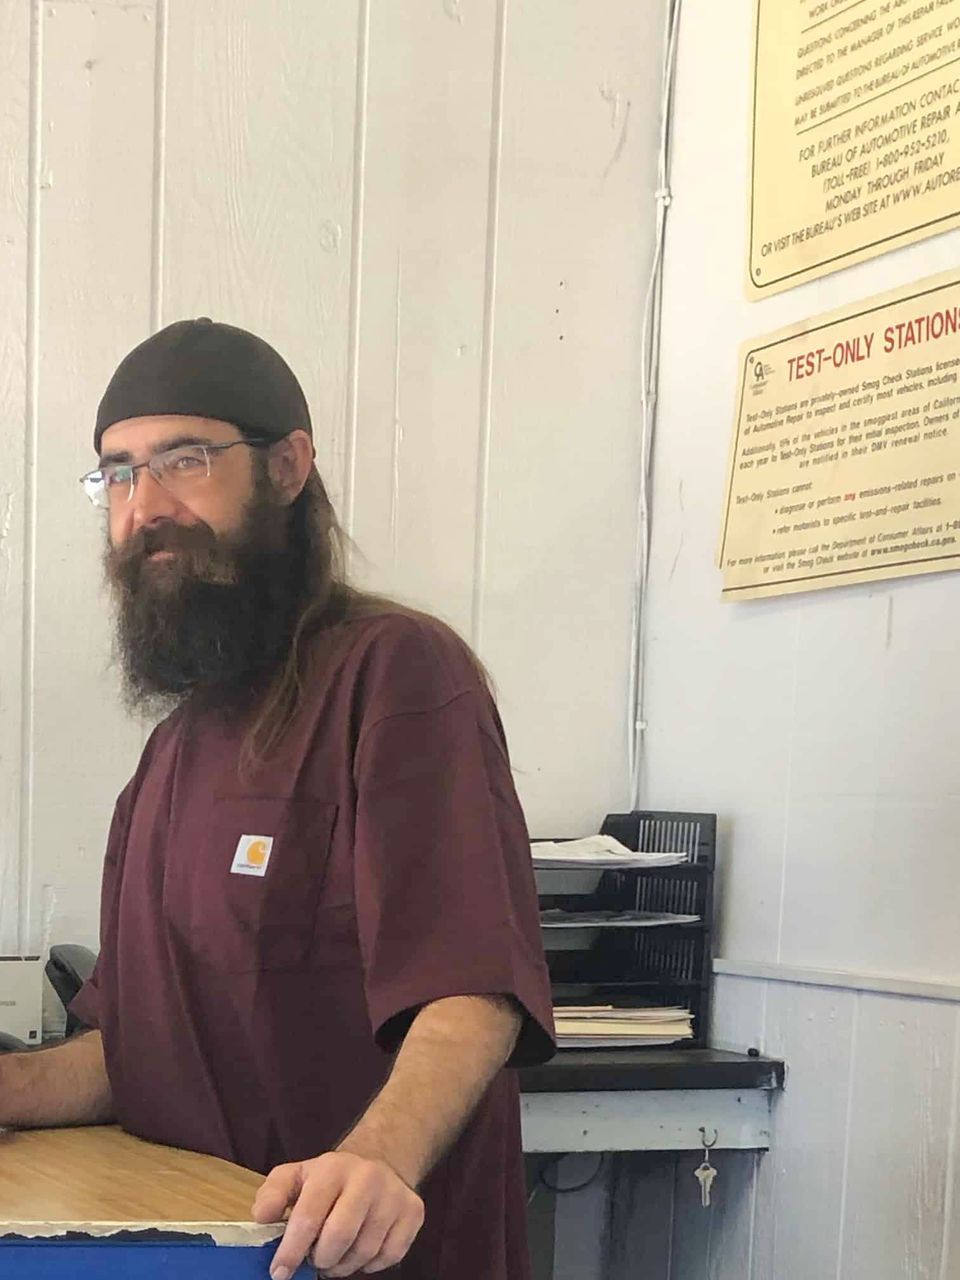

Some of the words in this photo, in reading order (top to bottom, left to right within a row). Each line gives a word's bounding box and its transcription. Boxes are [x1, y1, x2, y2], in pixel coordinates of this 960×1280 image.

[796, 58, 824, 80] DIRECTED
[826, 52, 835, 64] TO
[837, 45, 848, 59] THE
[850, 28, 884, 52] MANAGER
[885, 21, 895, 35] OF
[898, 13, 912, 28] THIS
[834, 10, 877, 40] CONCERNING
[874, 40, 913, 68] REGARDING
[916, 25, 943, 47] SERVICE
[794, 112, 808, 126] MAY
[810, 107, 817, 119] BE
[910, 40, 956, 71] AUTOMOTIVE
[798, 146, 816, 163] FOR
[818, 127, 852, 154] FURTHER
[854, 100, 917, 138] INFORMATION
[811, 156, 843, 178] BUREAU
[845, 146, 858, 162] OF
[860, 119, 917, 156] AUTOMOTIVE
[920, 104, 951, 131] REPAIR
[825, 187, 862, 213] MONDAY
[867, 166, 909, 195] THROUGH
[913, 152, 945, 176] FRIDAY
[761, 242, 773, 257] OR
[774, 235, 791, 252] VISIT
[792, 228, 805, 245] THE
[805, 214, 842, 241] BUREAU'S
[843, 206, 861, 224] WEB
[862, 199, 878, 219] SITE
[879, 194, 890, 210] AT
[787, 332, 874, 382] TEST-ONLY
[861, 379, 880, 392] Smog
[883, 372, 902, 386] Check
[906, 363, 933, 379] Stations
[877, 388, 894, 400] most
[927, 372, 958, 387] including
[901, 407, 920, 418] areas
[891, 433, 920, 448] renewal
